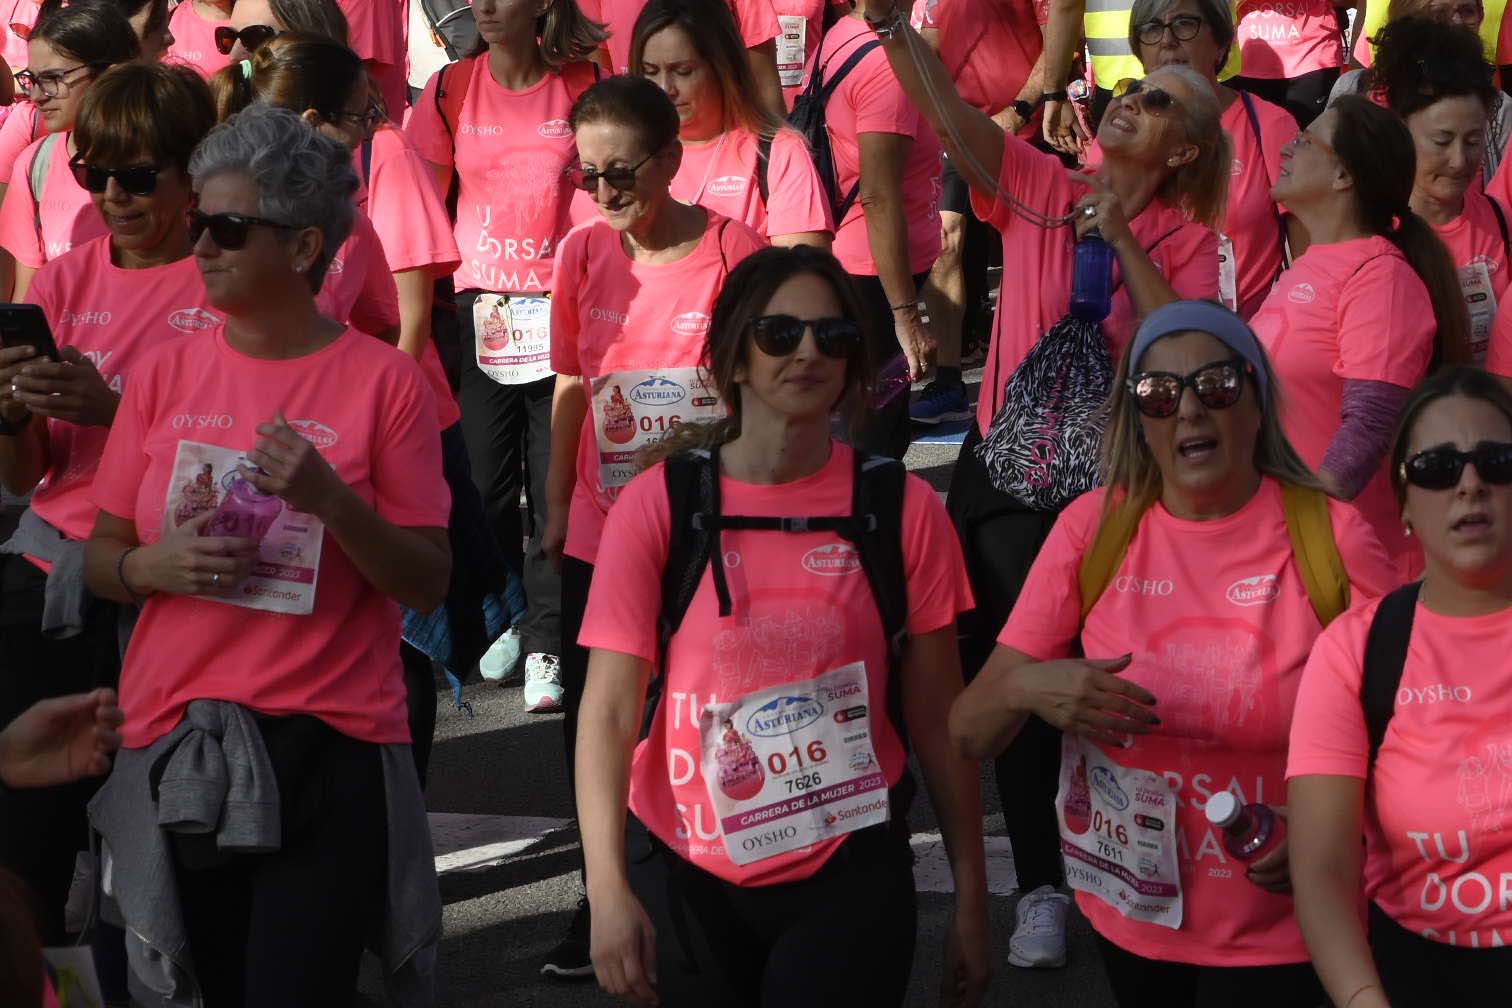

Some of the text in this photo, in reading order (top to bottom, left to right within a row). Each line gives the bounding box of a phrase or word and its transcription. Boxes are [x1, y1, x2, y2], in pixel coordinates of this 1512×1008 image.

[1249, 23, 1301, 40] SUMA
[461, 123, 503, 136] OYSHO
[471, 258, 543, 291] SUMA
[590, 308, 630, 326] OYSHO
[512, 328, 548, 341] 016
[488, 357, 518, 365] CARRERA
[518, 356, 527, 364] DE
[527, 356, 535, 364] LA
[487, 369, 519, 378] OYSHO
[635, 389, 682, 401] ASTURIANA
[172, 413, 233, 430] OYSHO
[639, 415, 682, 433] 016
[611, 469, 639, 479] OYS
[1115, 575, 1175, 596] OSHO
[826, 685, 861, 702] SUMA
[1398, 684, 1472, 706] OYSHO
[753, 705, 820, 733] ASTURIANA
[767, 740, 828, 775] 016
[784, 771, 822, 794] 7626
[740, 777, 881, 826] CARRERA DE LA MUJER 2023
[1134, 792, 1165, 807] SUMA
[1093, 810, 1129, 845] 016
[742, 825, 797, 852] OYSHO
[1406, 830, 1470, 864] TU
[1097, 840, 1123, 862] 7611
